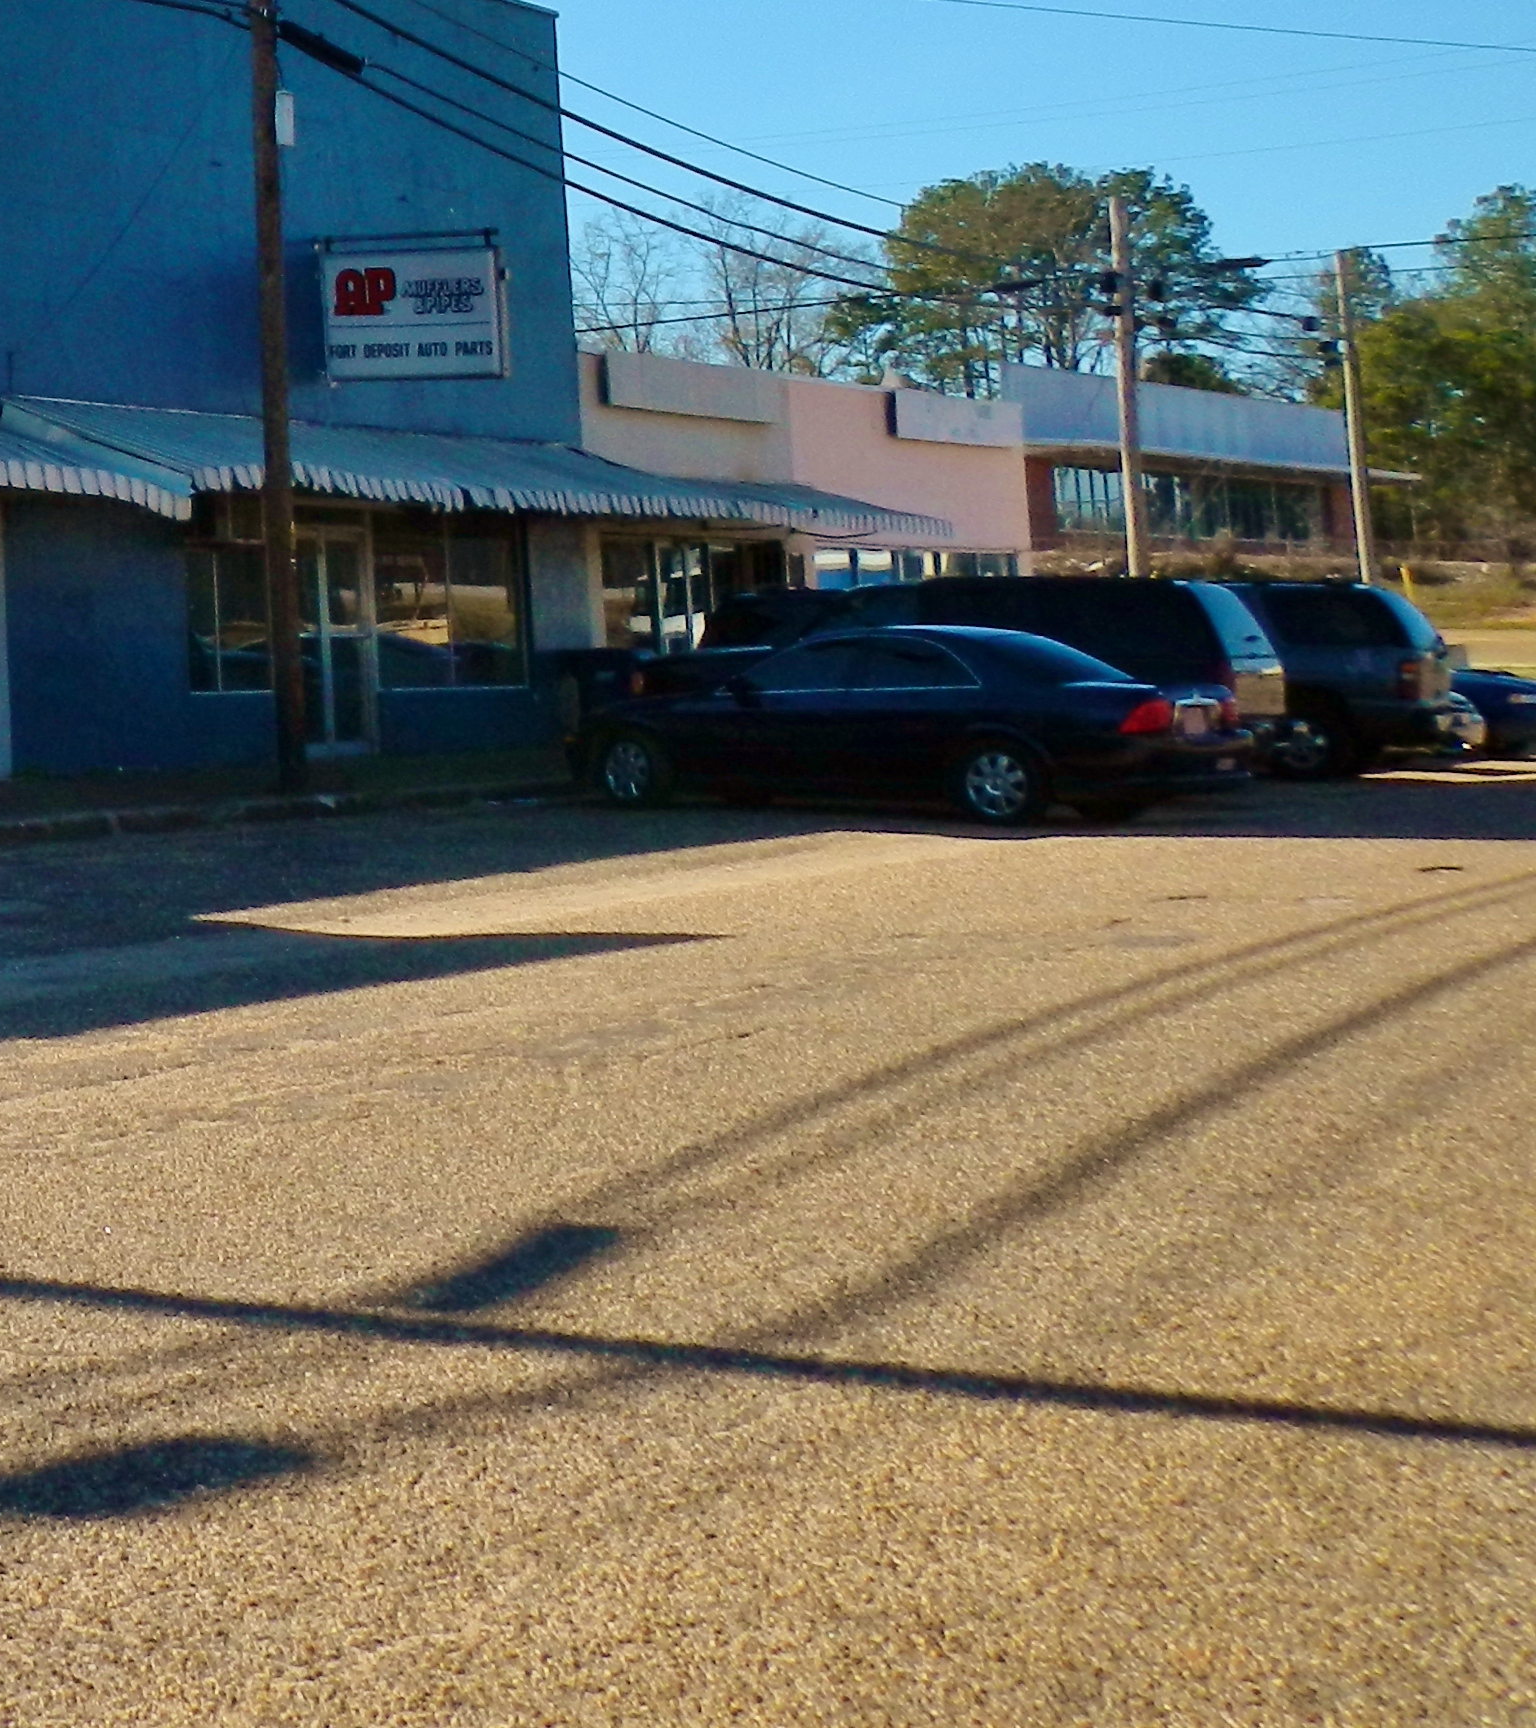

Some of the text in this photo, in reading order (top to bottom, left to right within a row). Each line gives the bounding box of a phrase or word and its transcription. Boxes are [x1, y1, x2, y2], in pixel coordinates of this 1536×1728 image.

[333, 266, 396, 316] AP
[329, 339, 493, 360] FORT DEPOSIT AUTO PARTS
